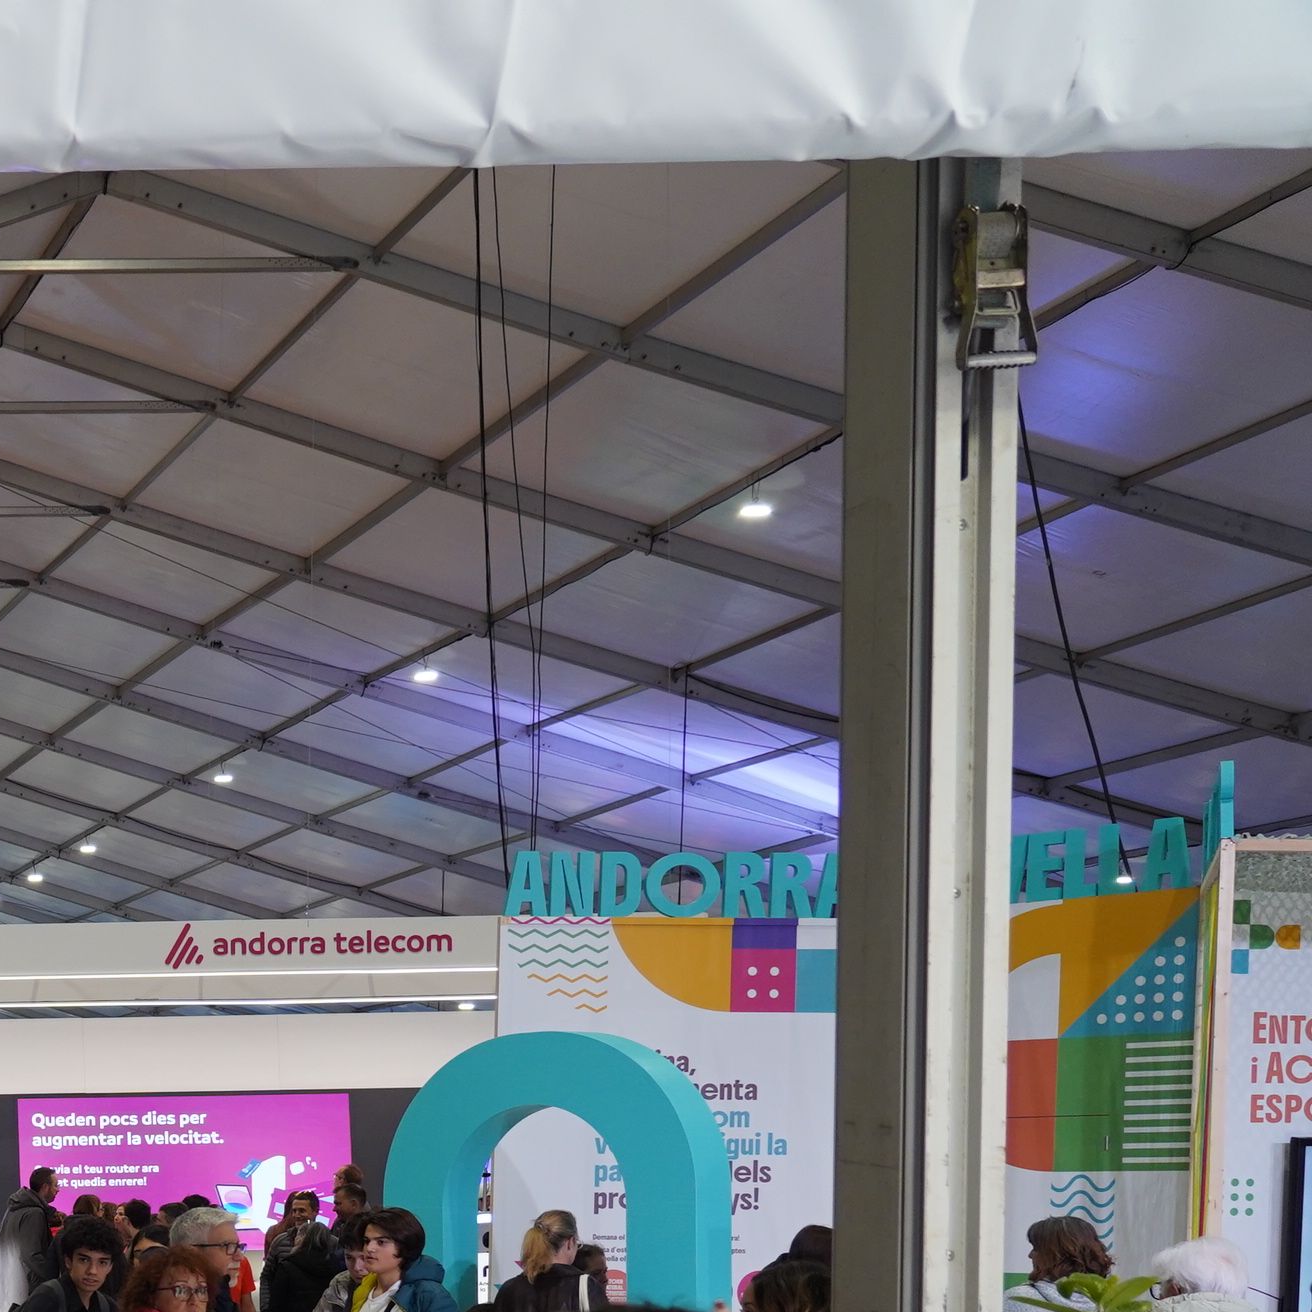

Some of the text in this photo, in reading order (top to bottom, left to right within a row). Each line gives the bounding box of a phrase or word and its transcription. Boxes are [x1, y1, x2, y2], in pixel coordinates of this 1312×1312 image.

[213, 930, 452, 955] andorra telecom
[1253, 1012, 1312, 1044] ENT
[1251, 1056, 1258, 1084] i
[694, 1080, 758, 1101] enta
[32, 1111, 207, 1129] Queden pocs dies per
[712, 1110, 750, 1127] om
[1250, 1094, 1312, 1124] ESP
[32, 1130, 224, 1150] augmentar la velocitat.
[767, 1132, 788, 1156] la
[72, 1164, 82, 1174] el
[84, 1165, 103, 1174] teu
[105, 1165, 140, 1174] router
[141, 1165, 159, 1173] ara
[729, 1160, 772, 1183] els
[71, 1177, 107, 1188] quedis
[108, 1177, 147, 1187] enrere!
